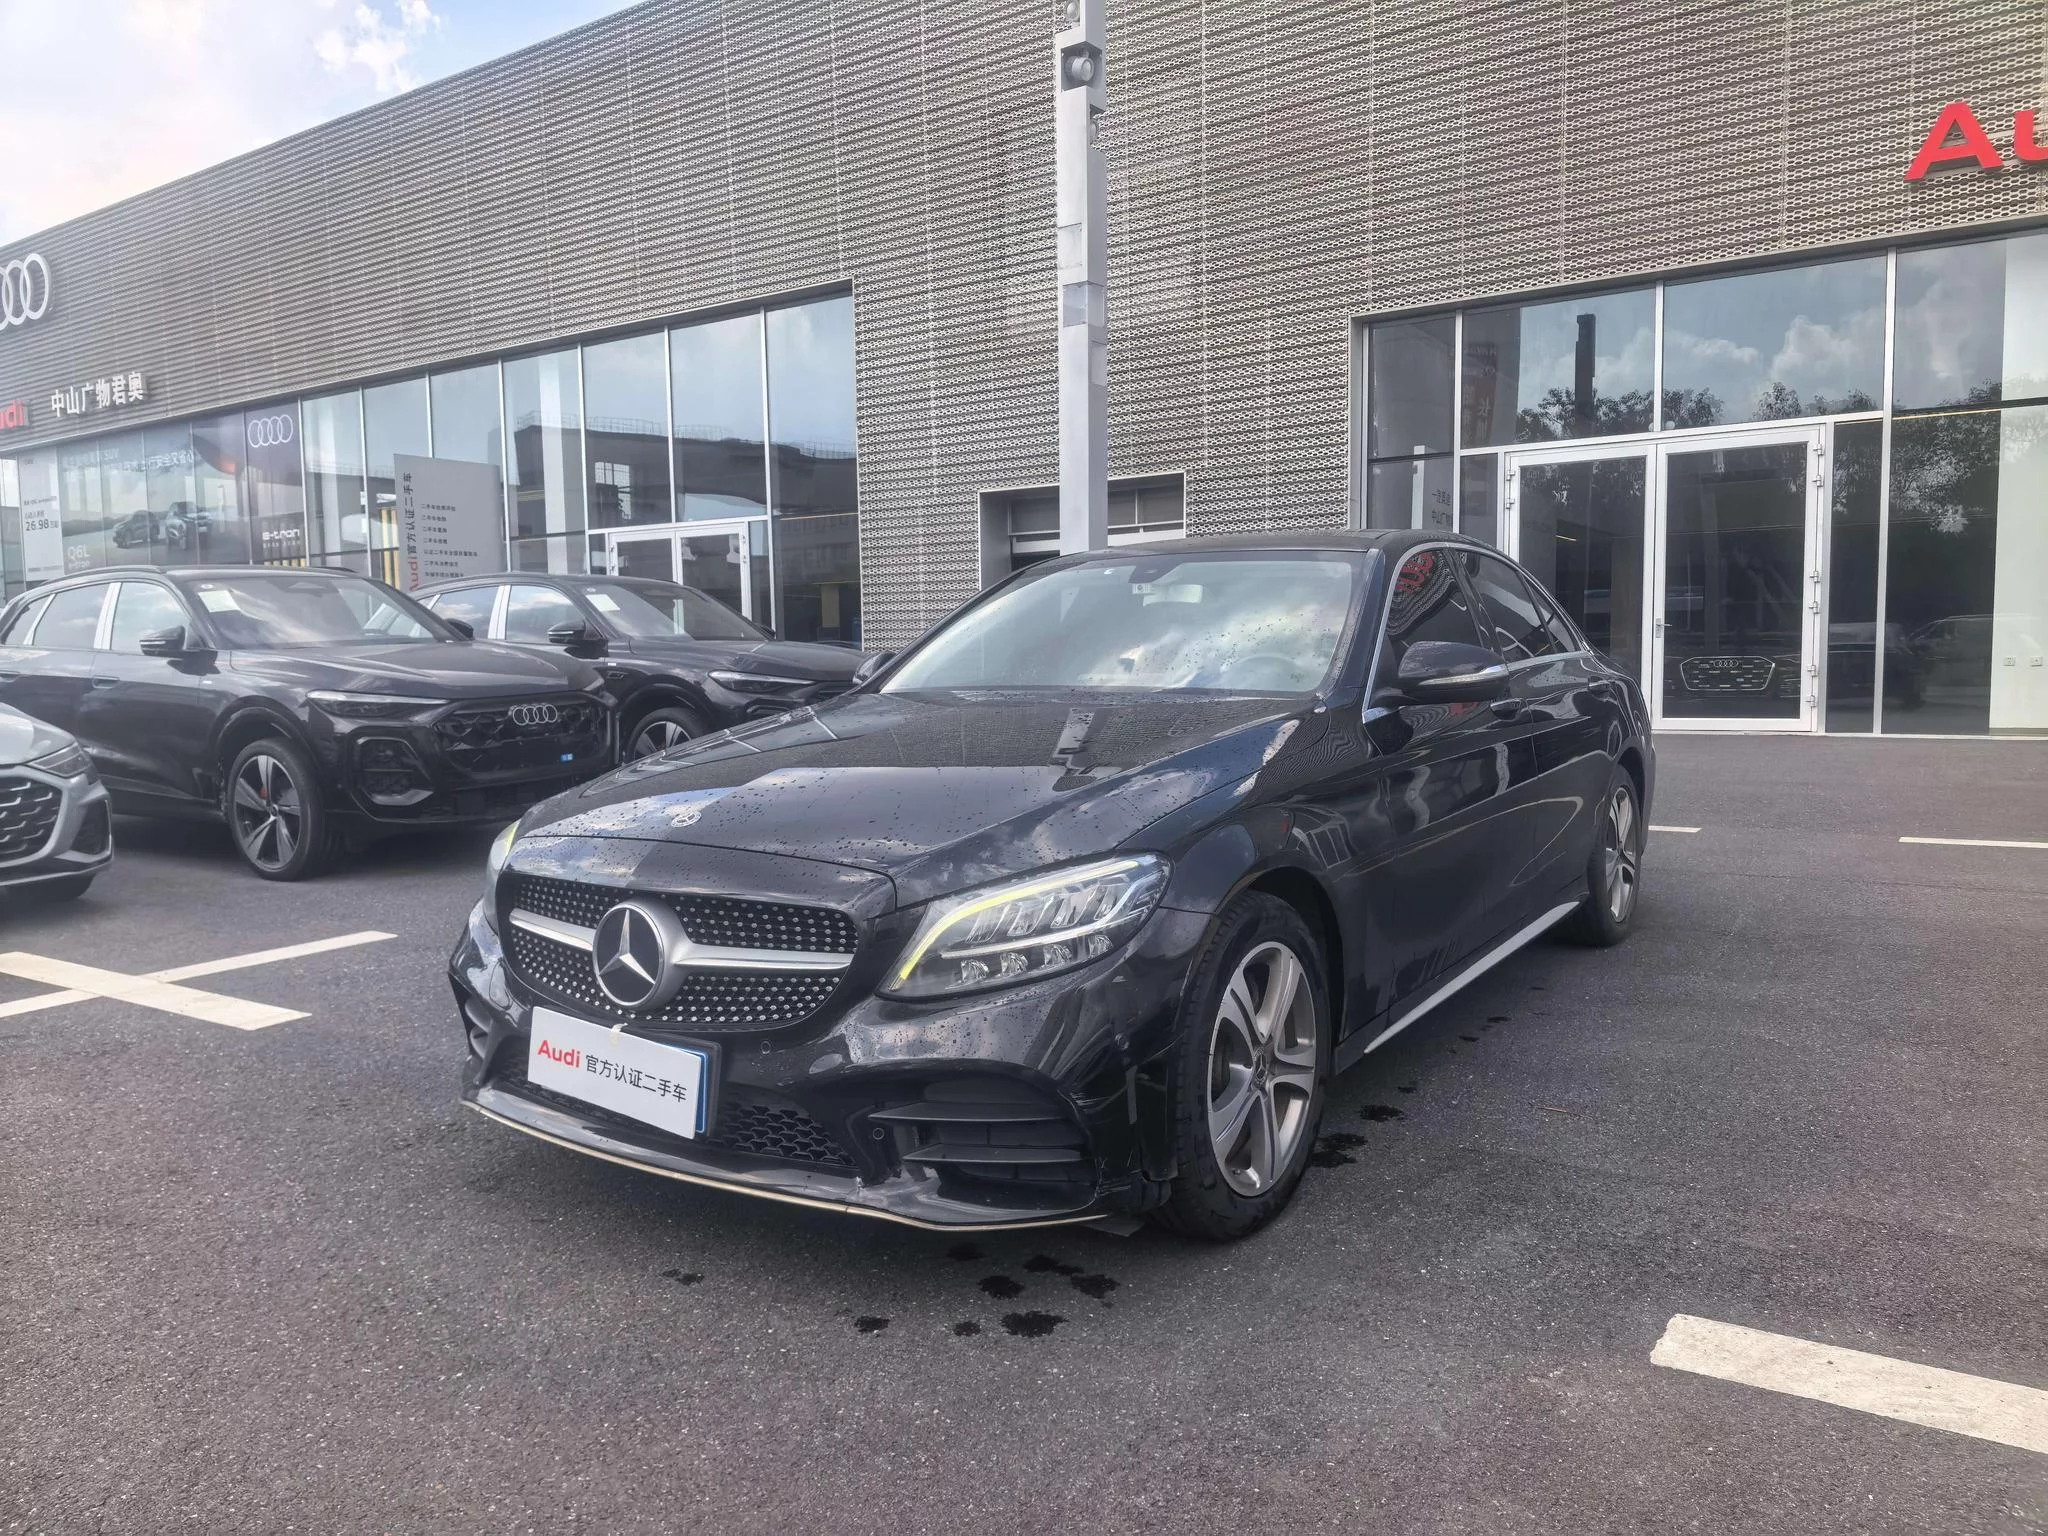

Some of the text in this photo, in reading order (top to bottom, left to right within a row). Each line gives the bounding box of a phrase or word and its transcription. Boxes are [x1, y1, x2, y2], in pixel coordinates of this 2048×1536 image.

[51, 371, 143, 418] 中山广物君奥
[537, 1039, 688, 1103] Audi 官方认证二手车
